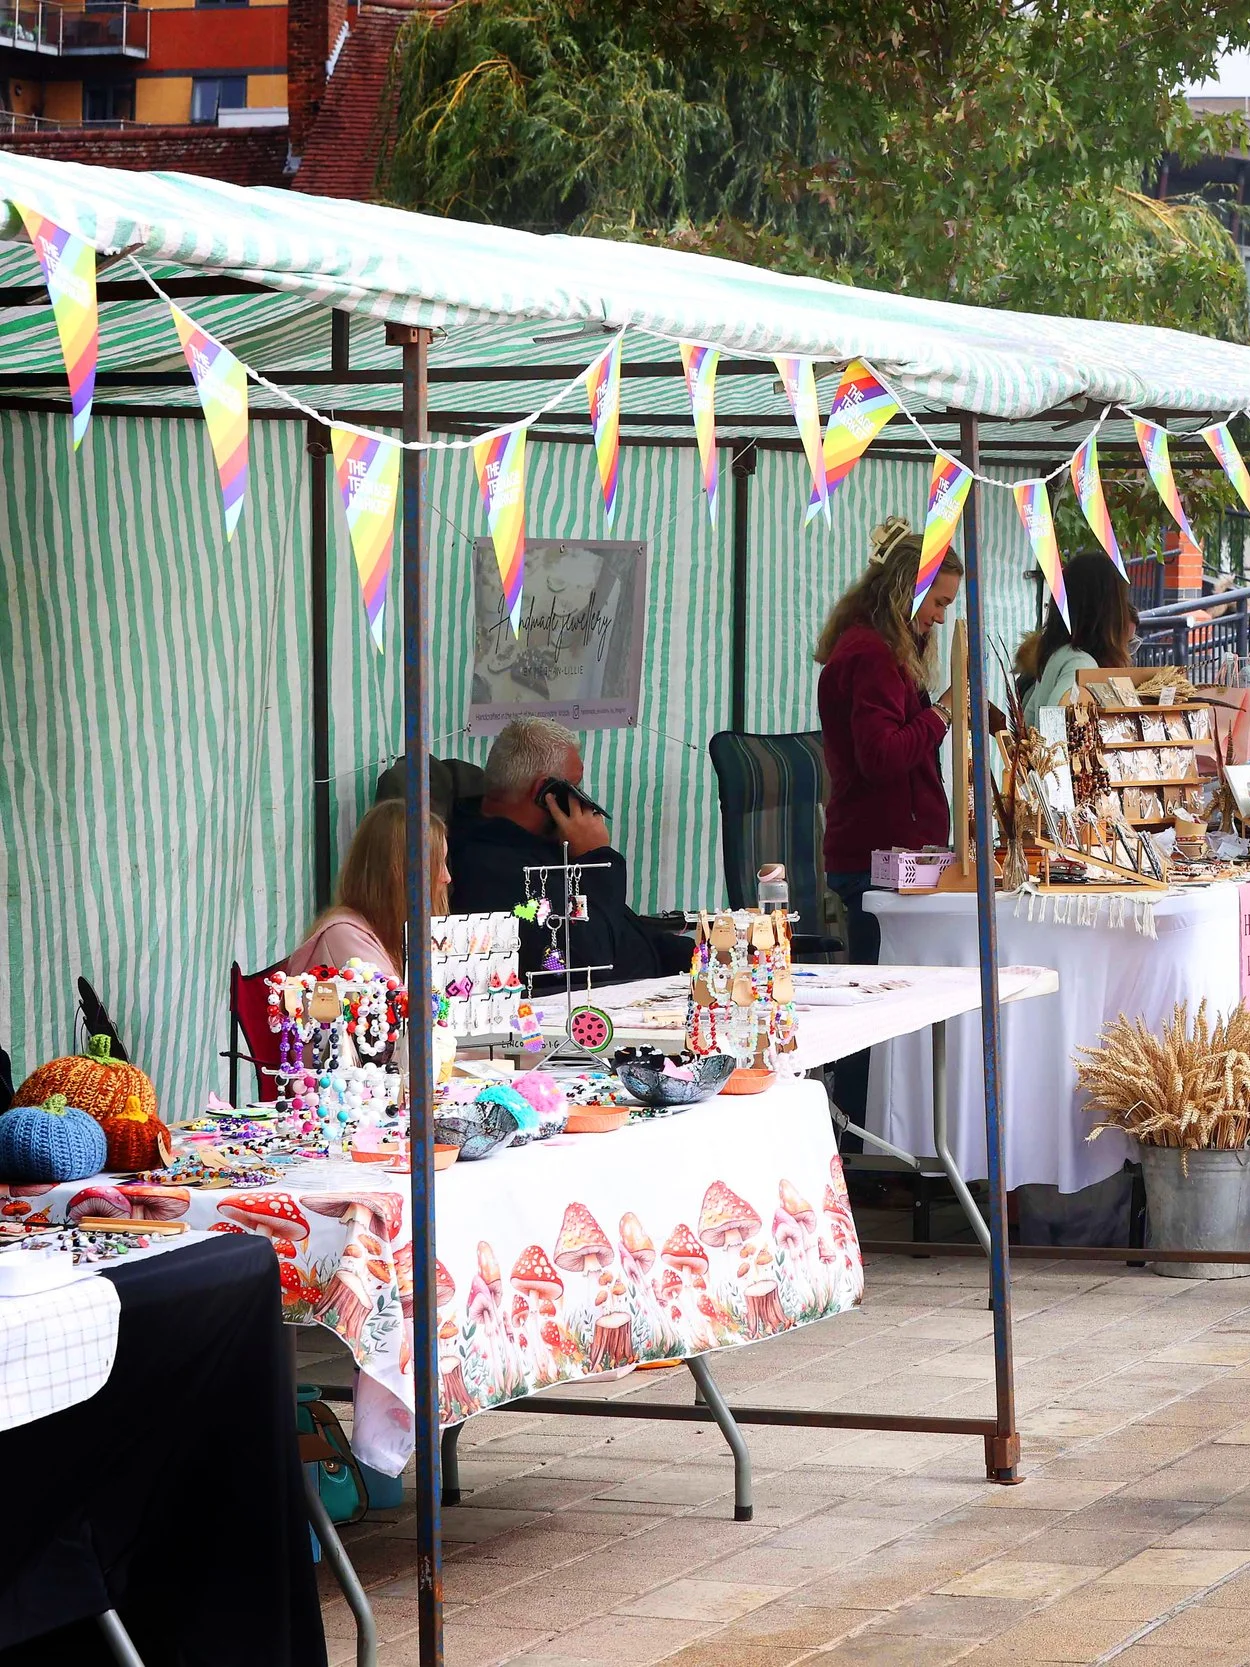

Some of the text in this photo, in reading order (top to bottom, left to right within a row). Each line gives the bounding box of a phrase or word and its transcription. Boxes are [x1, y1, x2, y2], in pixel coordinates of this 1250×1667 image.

[847, 382, 865, 406] THE
[347, 457, 367, 478] THE
[485, 460, 501, 480] THE
[937, 476, 950, 493] THE
[489, 592, 559, 655] Hndmade
